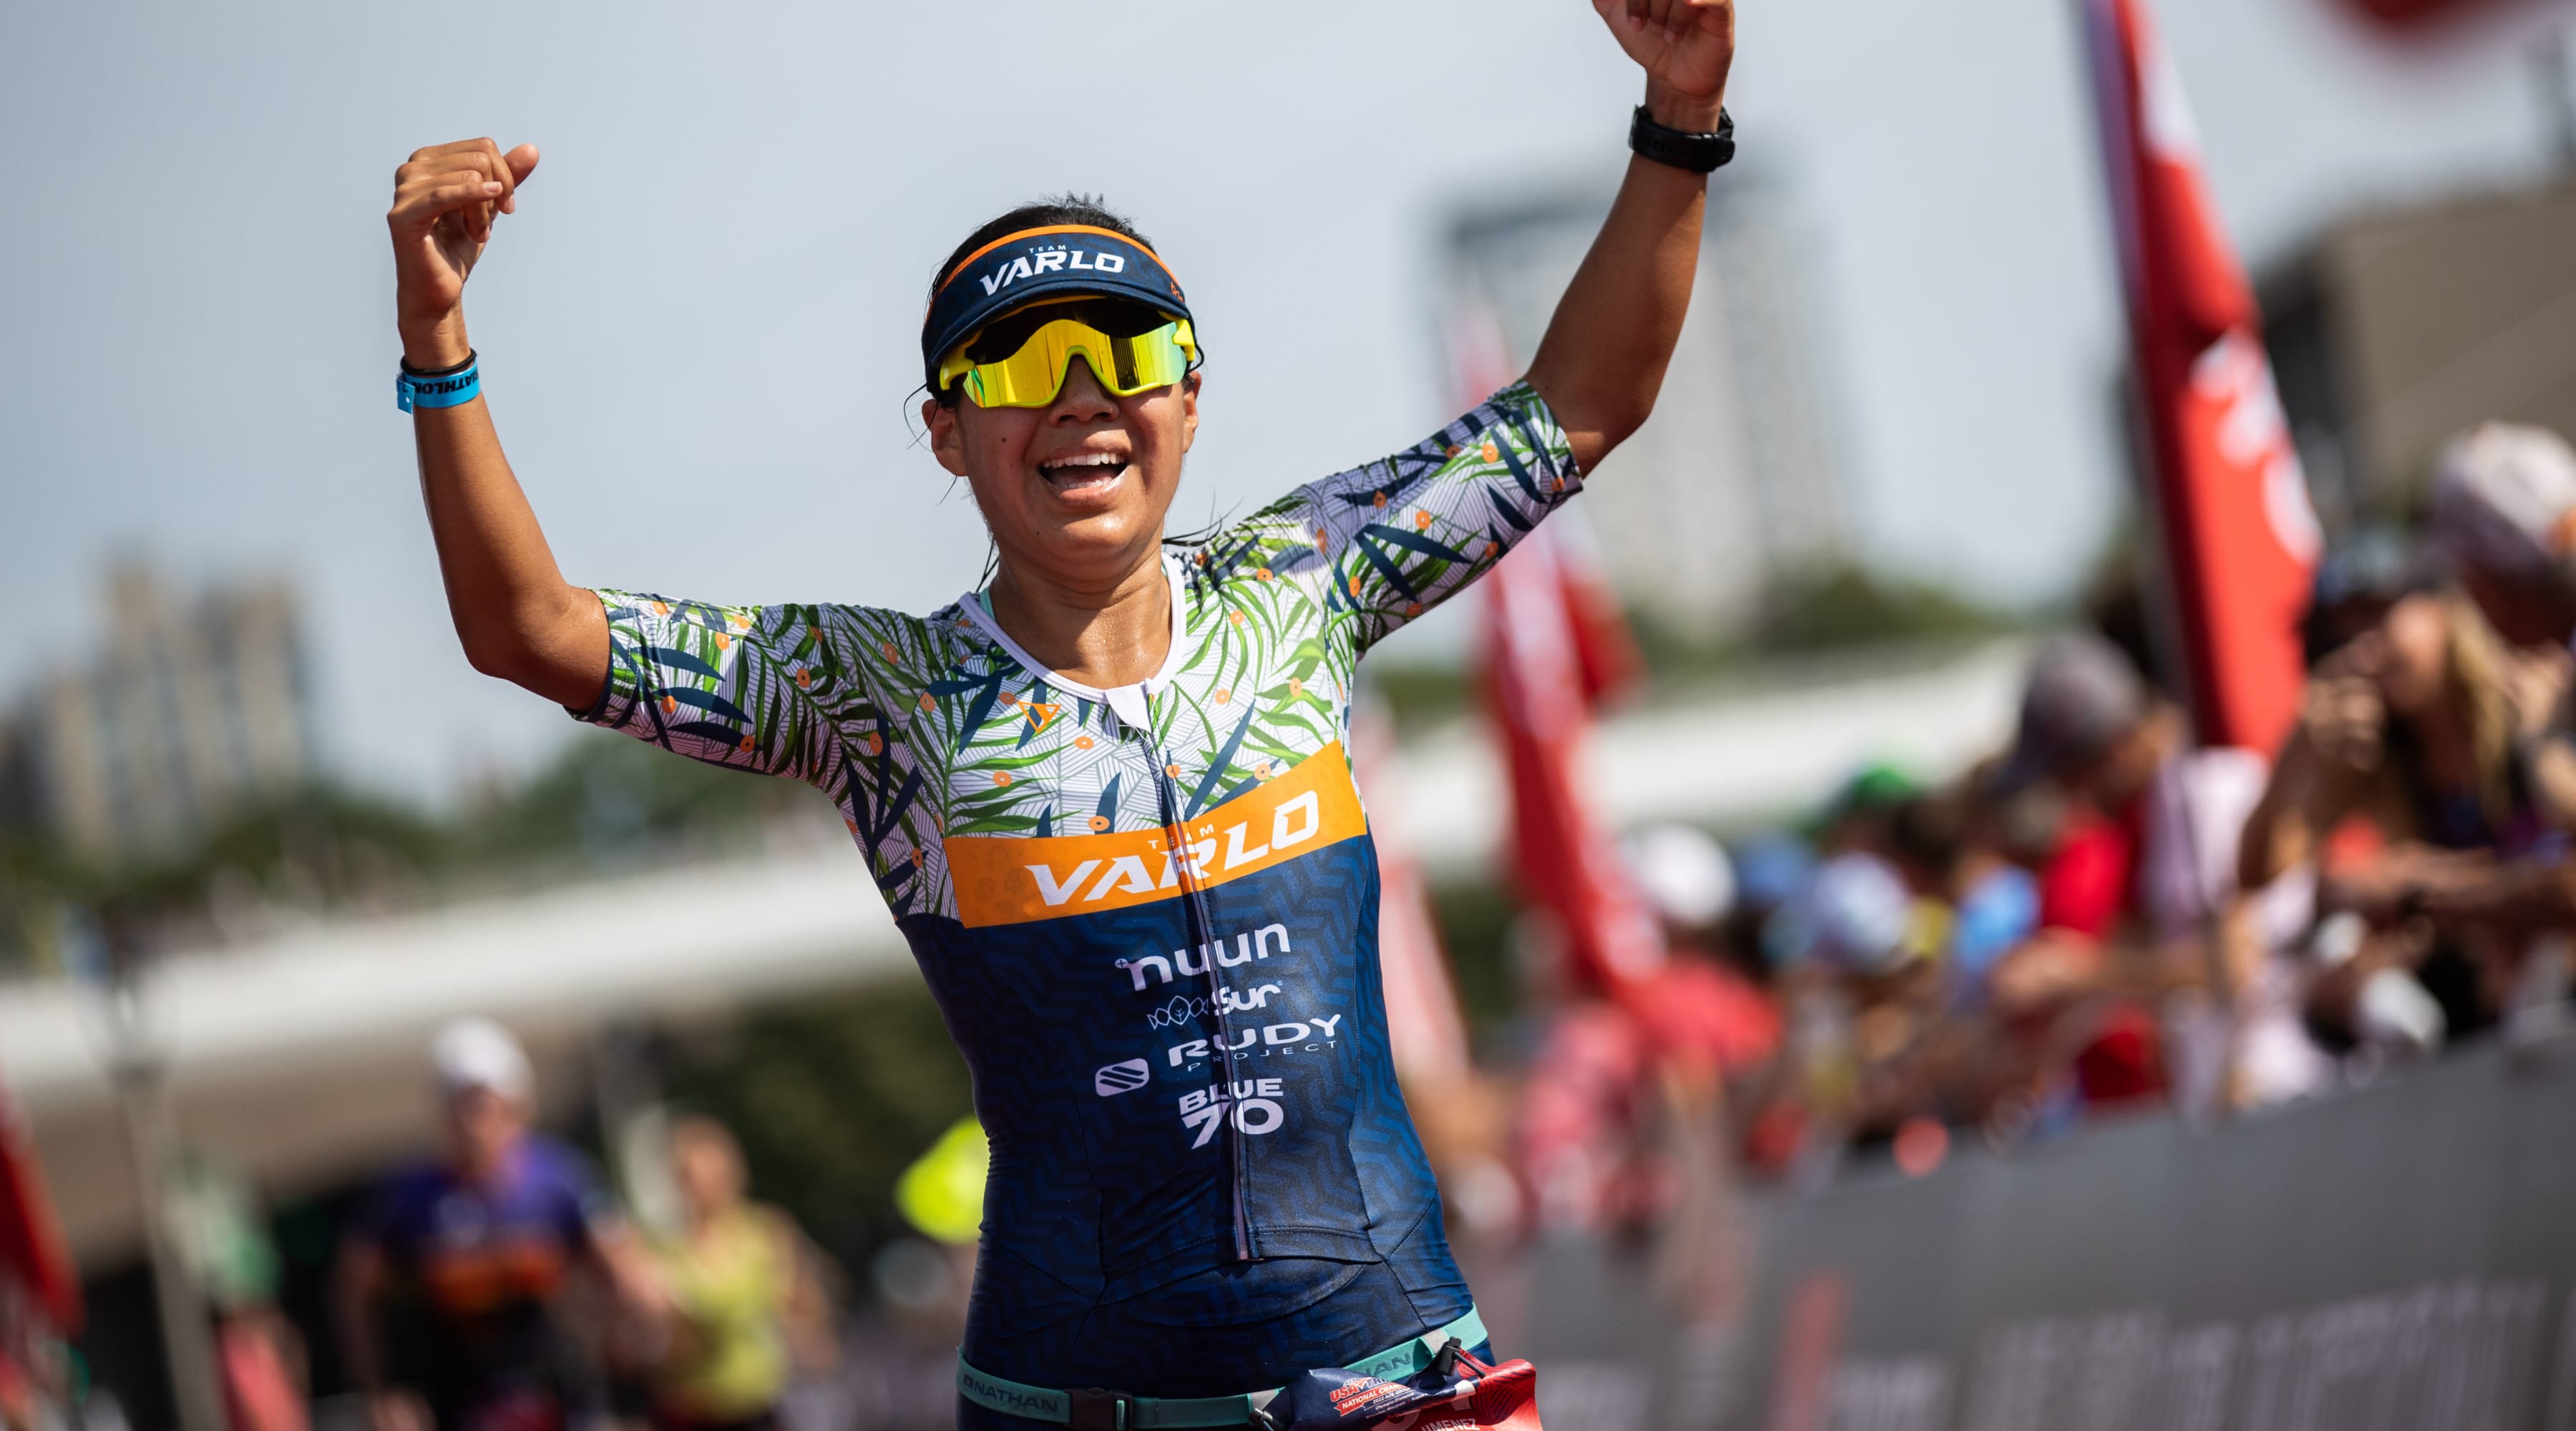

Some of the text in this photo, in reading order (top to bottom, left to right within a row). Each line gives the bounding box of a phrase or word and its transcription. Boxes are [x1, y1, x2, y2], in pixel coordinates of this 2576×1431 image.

[1028, 245, 1067, 255] TEAM
[979, 250, 1126, 296] VARLO
[1024, 790, 1319, 907] VARLO
[1121, 923, 1291, 991] nuun
[1168, 1014, 1341, 1067] RUDY
[1187, 1040, 1337, 1073] PROJECT
[1179, 1078, 1284, 1115] BLUE
[1181, 1098, 1284, 1151] 70
[974, 1382, 1058, 1413] NATHAN
[1330, 1384, 1360, 1402] USA
[1342, 1391, 1379, 1410] NATIONAL
